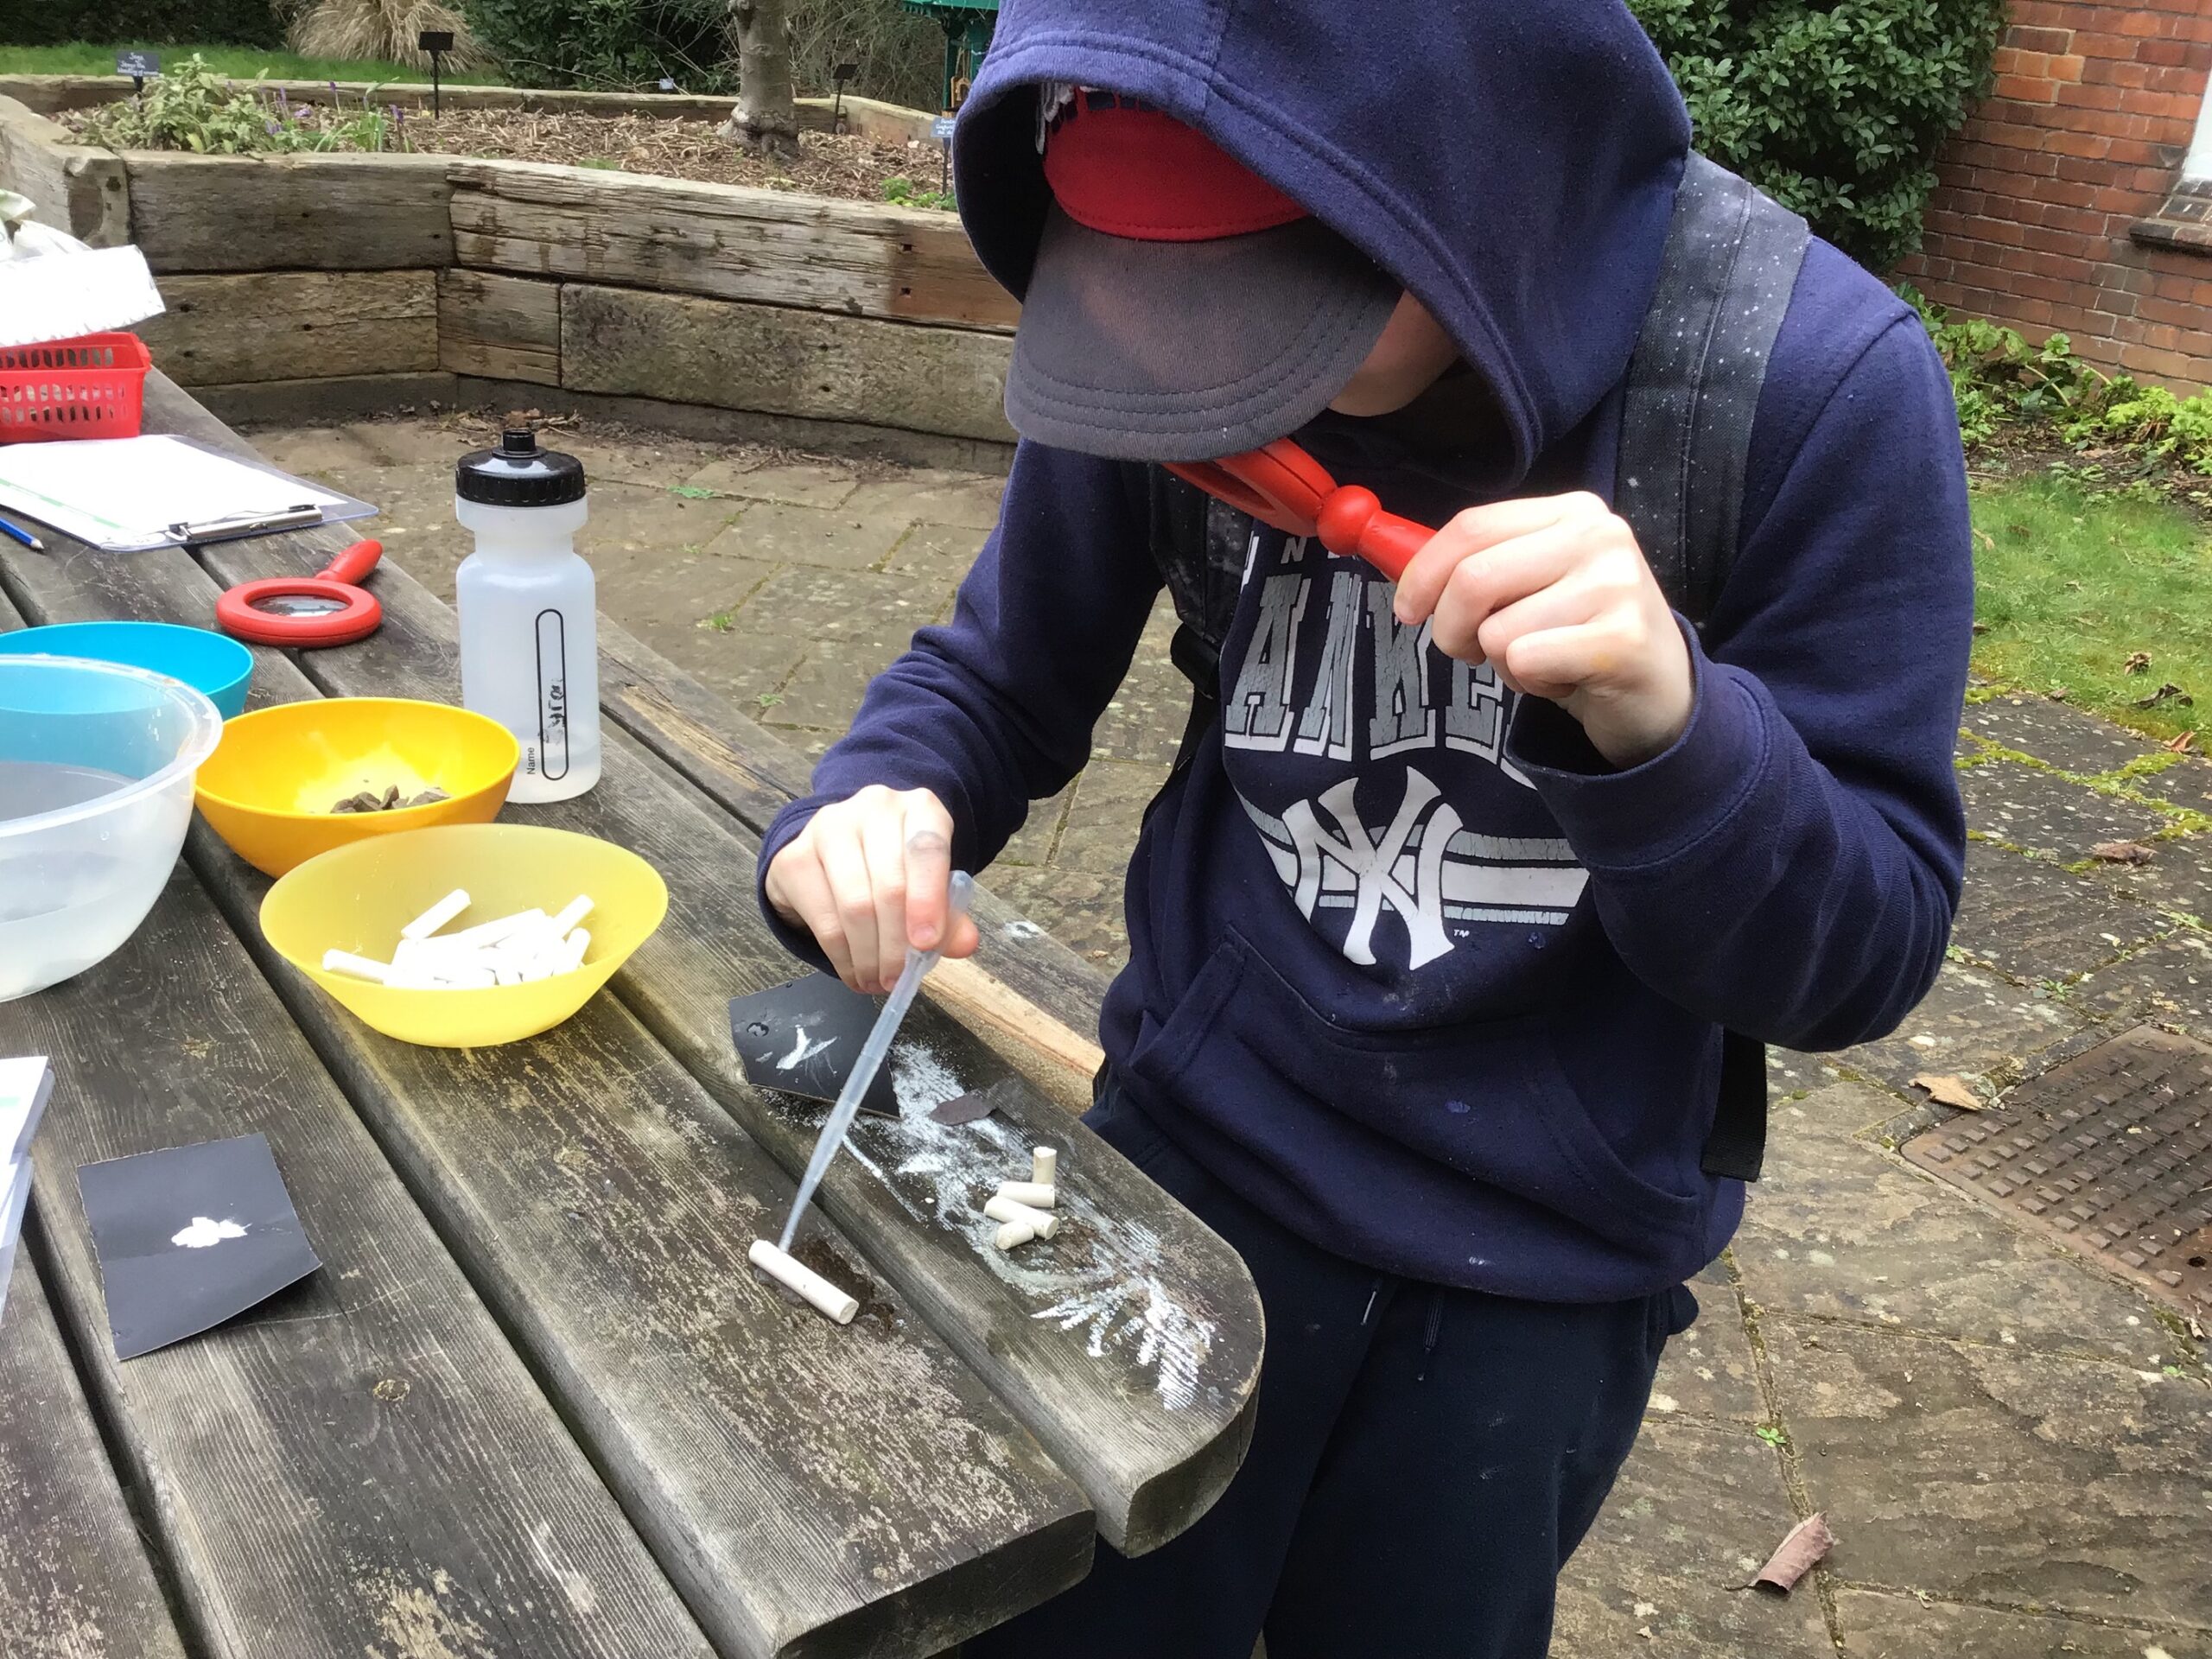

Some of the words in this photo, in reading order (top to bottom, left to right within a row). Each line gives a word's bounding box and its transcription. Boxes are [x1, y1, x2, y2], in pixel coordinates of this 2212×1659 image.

[526, 747, 536, 775] Name
[1282, 766, 1464, 970] NY
[1453, 929, 1470, 938] TM
